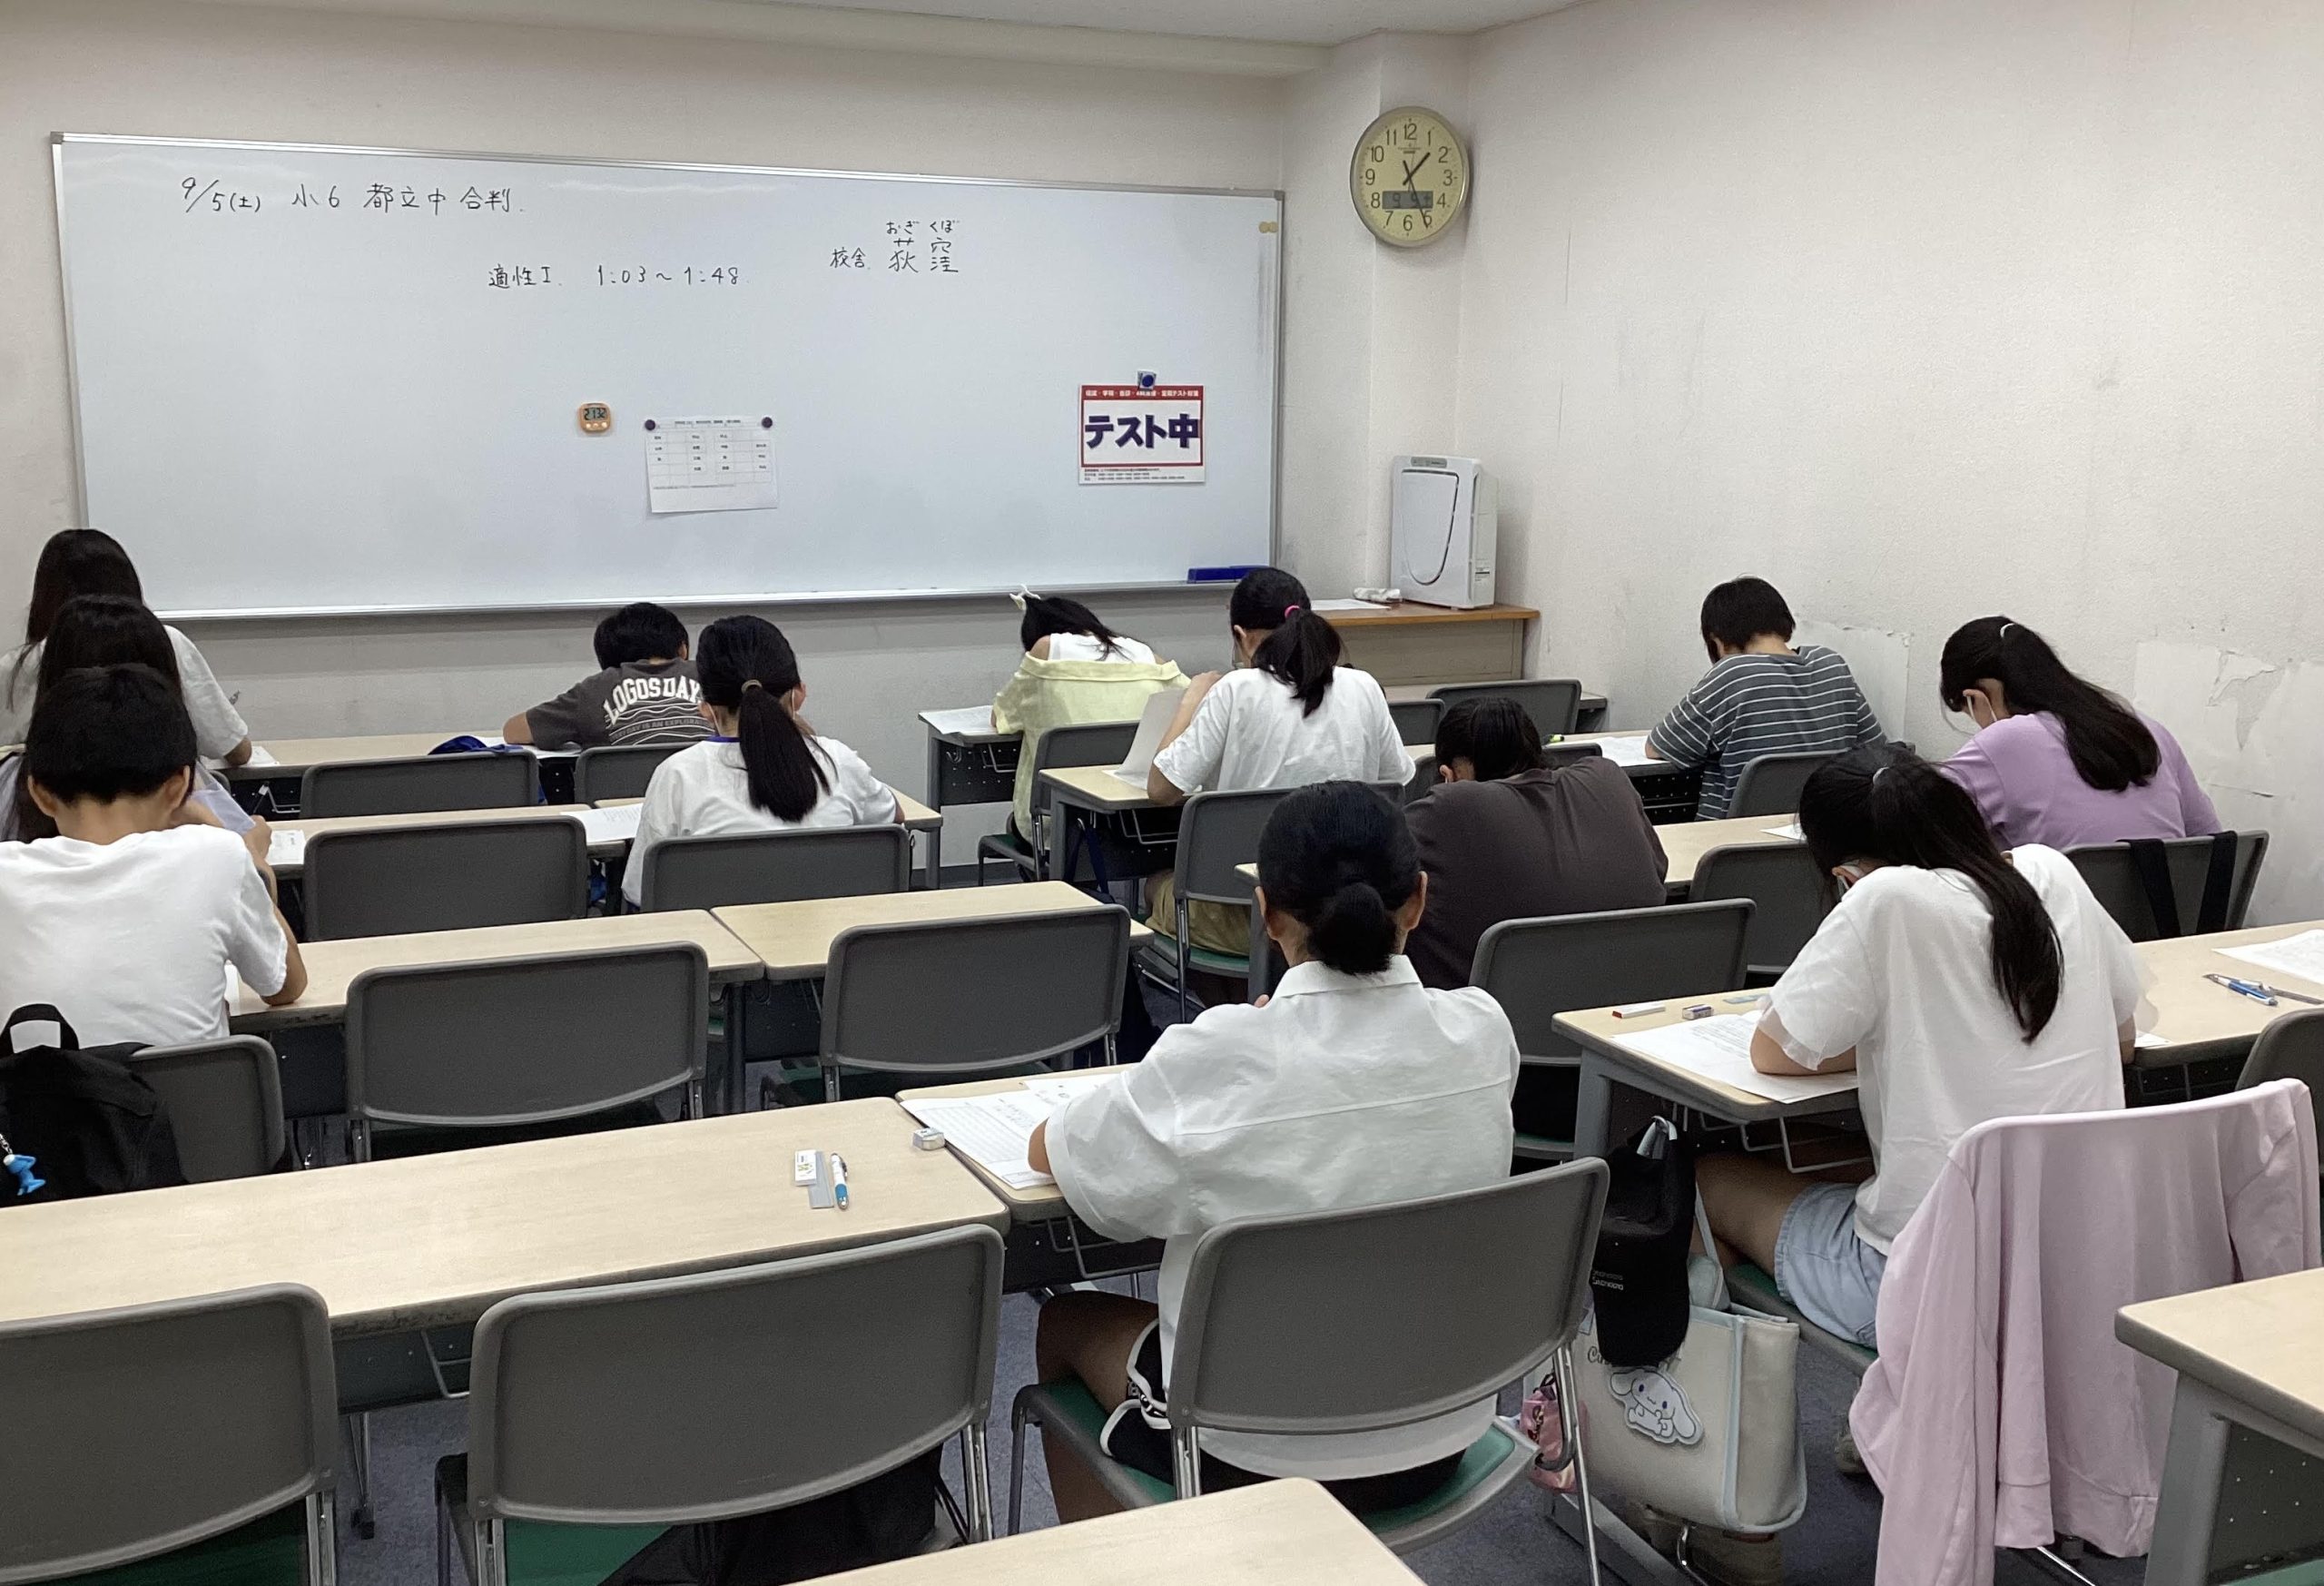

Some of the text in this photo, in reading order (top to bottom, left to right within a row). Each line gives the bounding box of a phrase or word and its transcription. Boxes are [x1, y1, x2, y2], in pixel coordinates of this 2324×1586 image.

[1386, 129, 1397, 145] 11
[1403, 123, 1417, 141] 12
[1371, 145, 1384, 163] 10
[1438, 145, 1449, 163] 2
[1364, 168, 1375, 186] 9
[1443, 169, 1452, 186] 3
[181, 176, 261, 214] 9/5(土)
[290, 182, 340, 209] 小6
[362, 182, 447, 217] 都立中
[1371, 192, 1381, 209] 8
[1436, 192, 1447, 208] 4
[1385, 210, 1394, 226] 7
[1403, 214, 1413, 231] 6
[1423, 210, 1433, 226] 5
[829, 236, 960, 274] 校舎 荻窪
[1085, 413, 1201, 449] テスト中
[604, 675, 703, 725] LOGOS DAY
